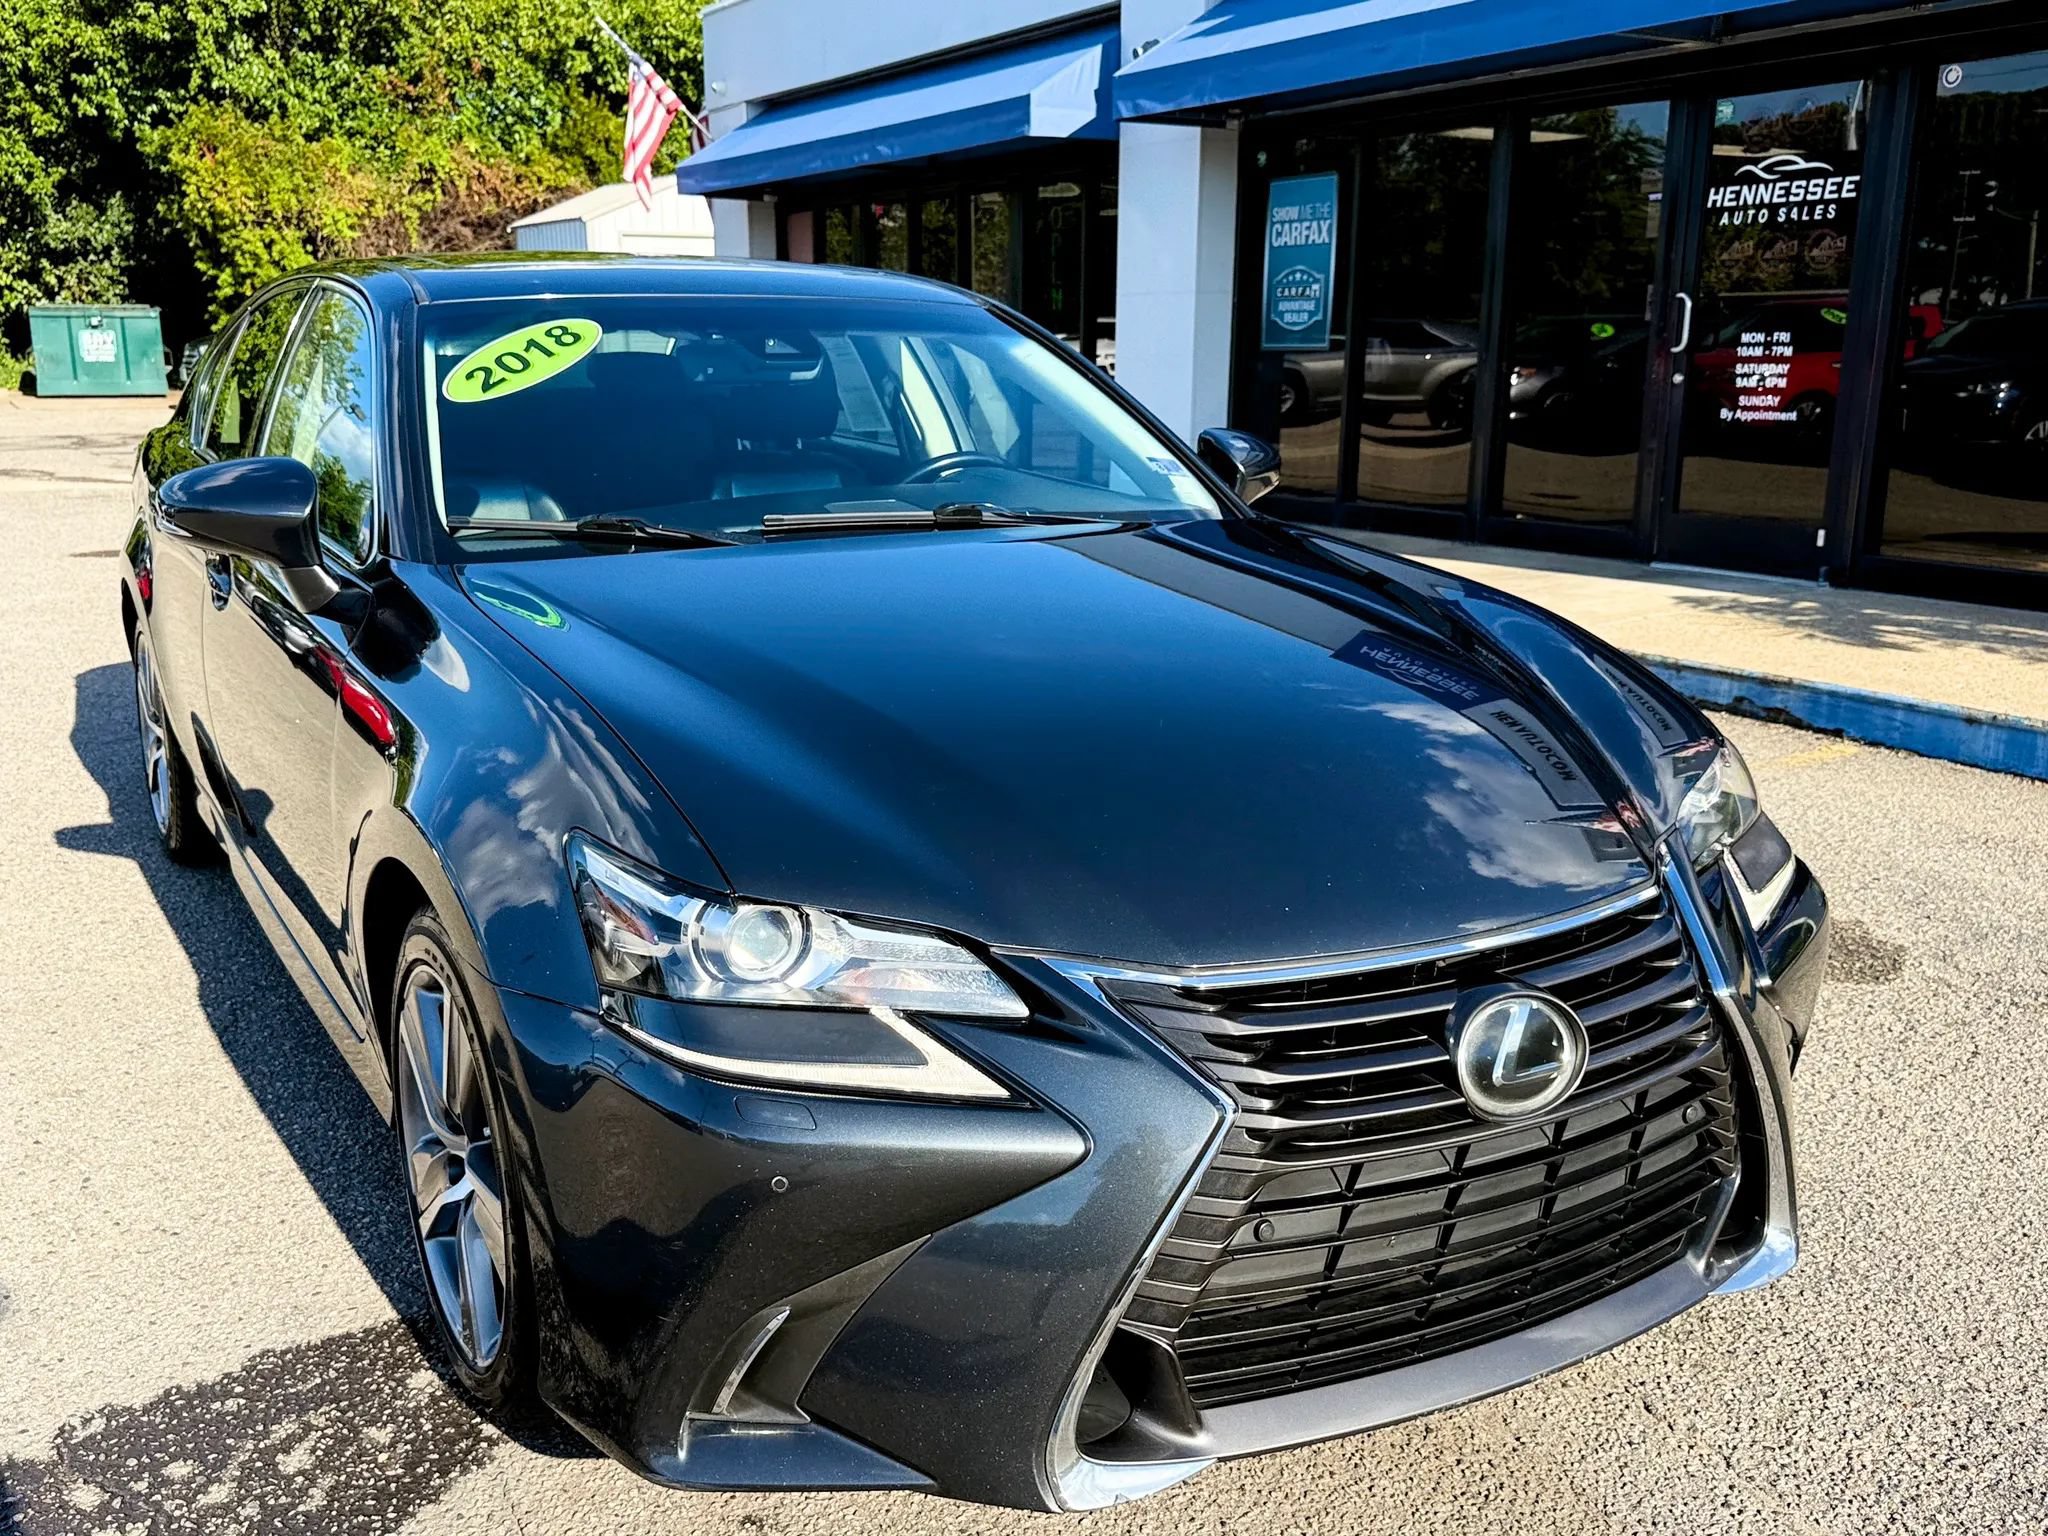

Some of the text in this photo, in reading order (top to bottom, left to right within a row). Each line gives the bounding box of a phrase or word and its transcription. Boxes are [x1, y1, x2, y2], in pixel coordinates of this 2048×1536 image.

[1707, 175, 1861, 208] HENNESSEE
[1272, 206, 1300, 222] SHOW
[1719, 204, 1837, 226] AUTO SALES
[1271, 219, 1331, 247] CARFAX
[1740, 332, 1765, 343] MON
[1773, 331, 1791, 343] FRI
[1736, 345, 1764, 357] 10AM
[1771, 345, 1793, 357] 7PM
[464, 325, 582, 394] 2018
[1735, 363, 1791, 375] SATURDAY
[1738, 395, 1781, 407] SUNDAY
[1720, 408, 1797, 422] By Appointment
